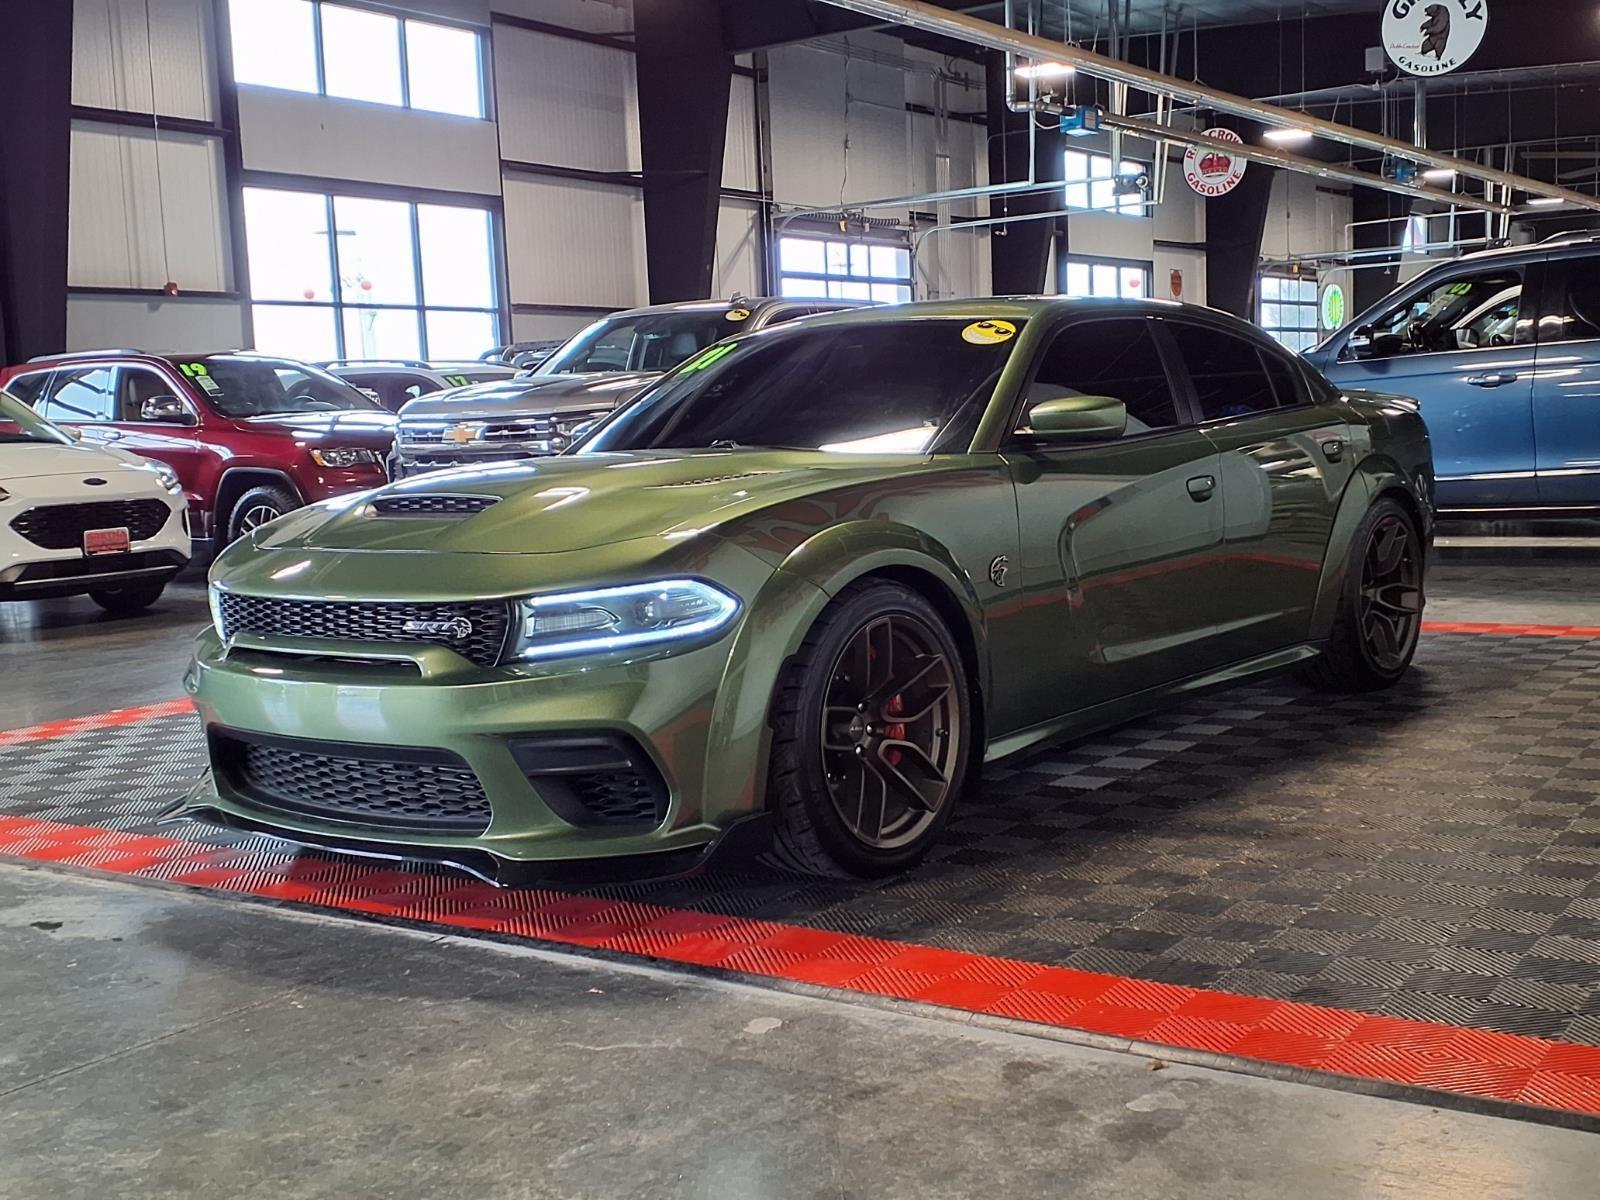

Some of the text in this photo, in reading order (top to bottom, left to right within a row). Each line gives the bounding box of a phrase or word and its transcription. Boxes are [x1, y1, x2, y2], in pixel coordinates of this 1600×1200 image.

[1398, 56, 1457, 73] GASOLINE
[1187, 170, 1241, 195] GASOLINE
[179, 362, 207, 377] 19
[402, 621, 457, 634] SRT
